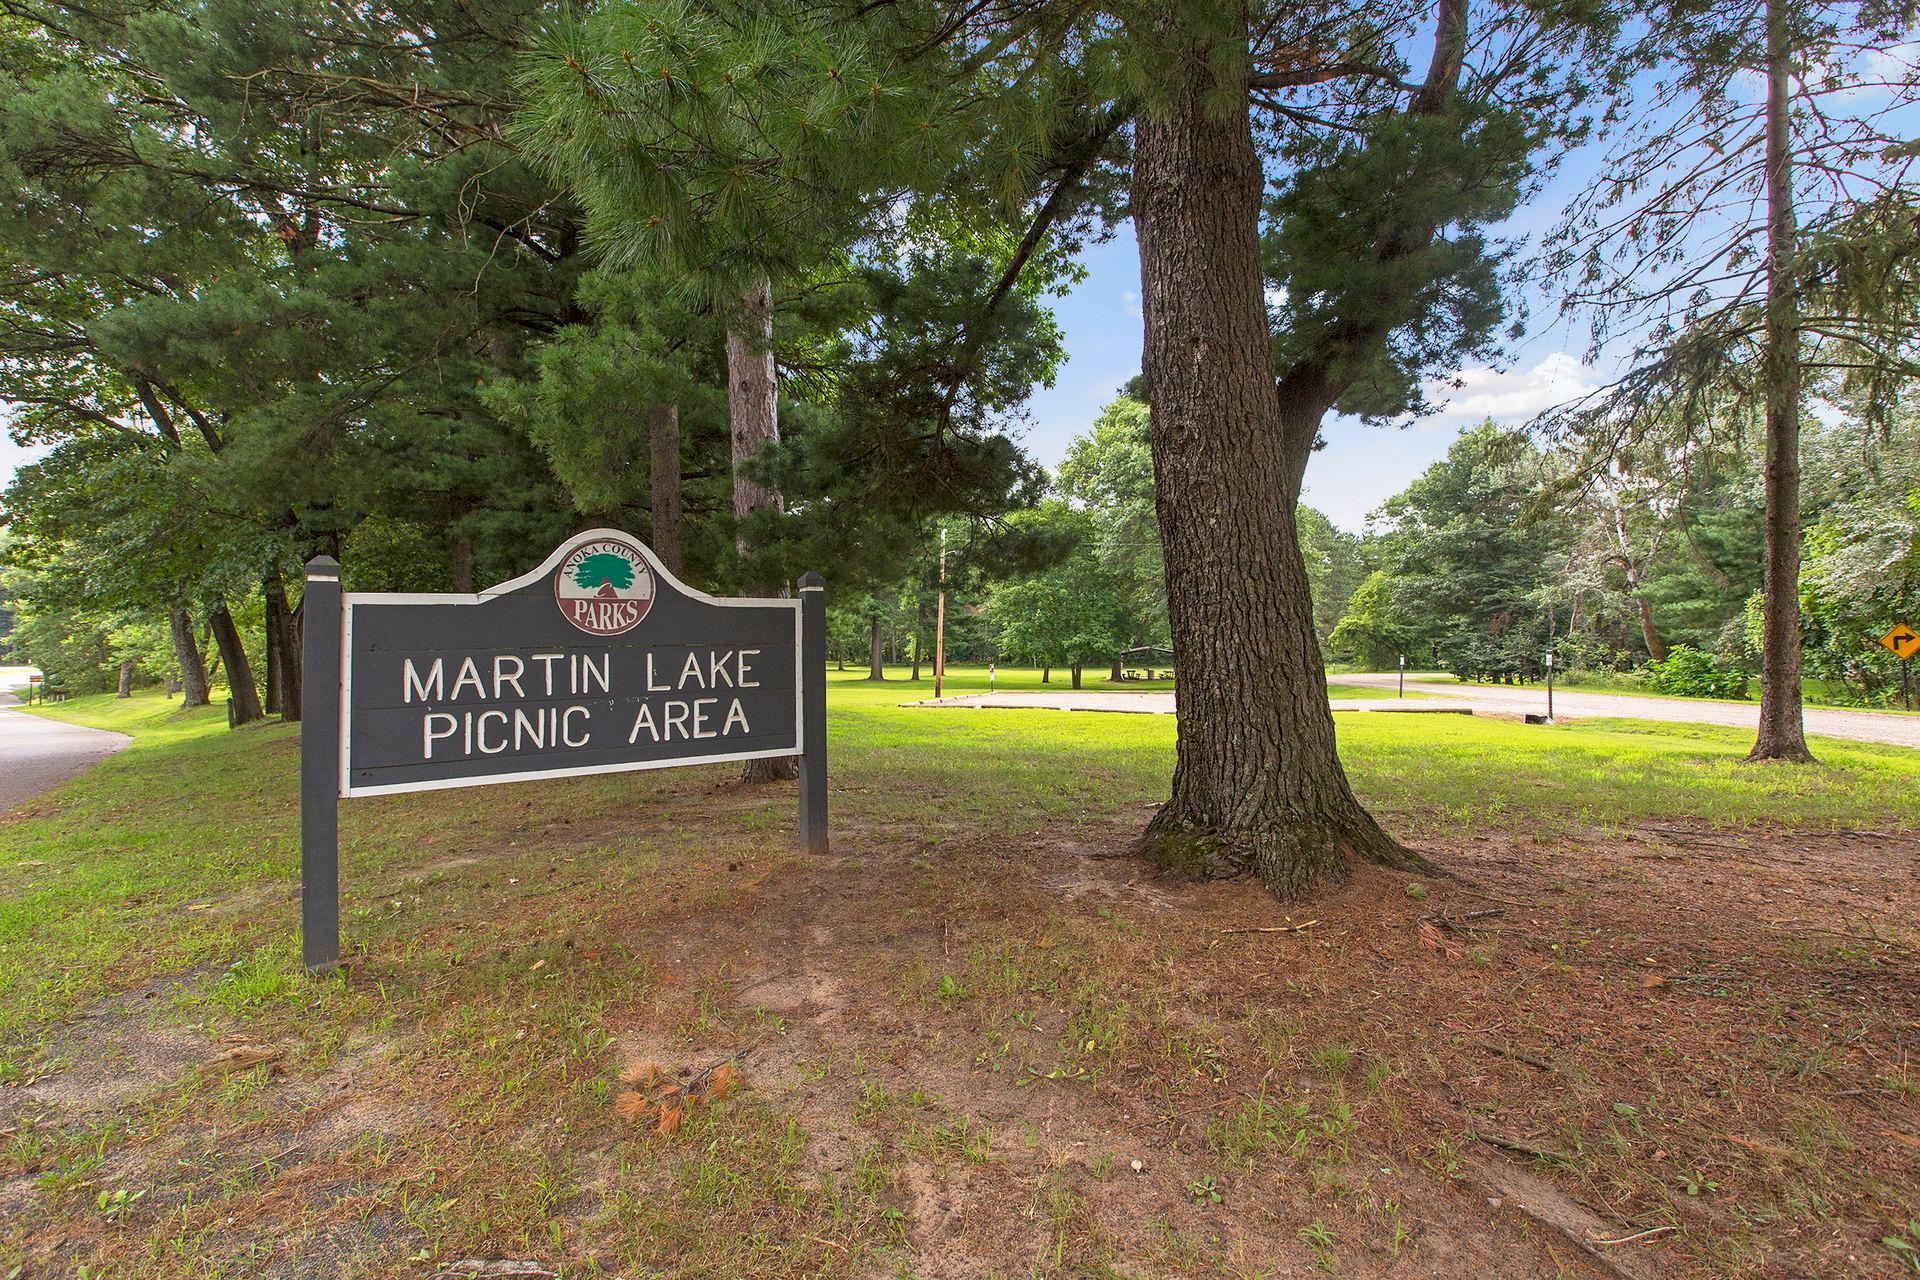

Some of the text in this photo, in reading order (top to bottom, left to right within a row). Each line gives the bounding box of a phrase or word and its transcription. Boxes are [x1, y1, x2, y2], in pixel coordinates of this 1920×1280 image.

[564, 543, 647, 578] ANOKA COUNTY
[574, 600, 638, 630] PARKS
[404, 649, 761, 703] MARTIN LAKE
[424, 697, 751, 759] PICNIC AREA
